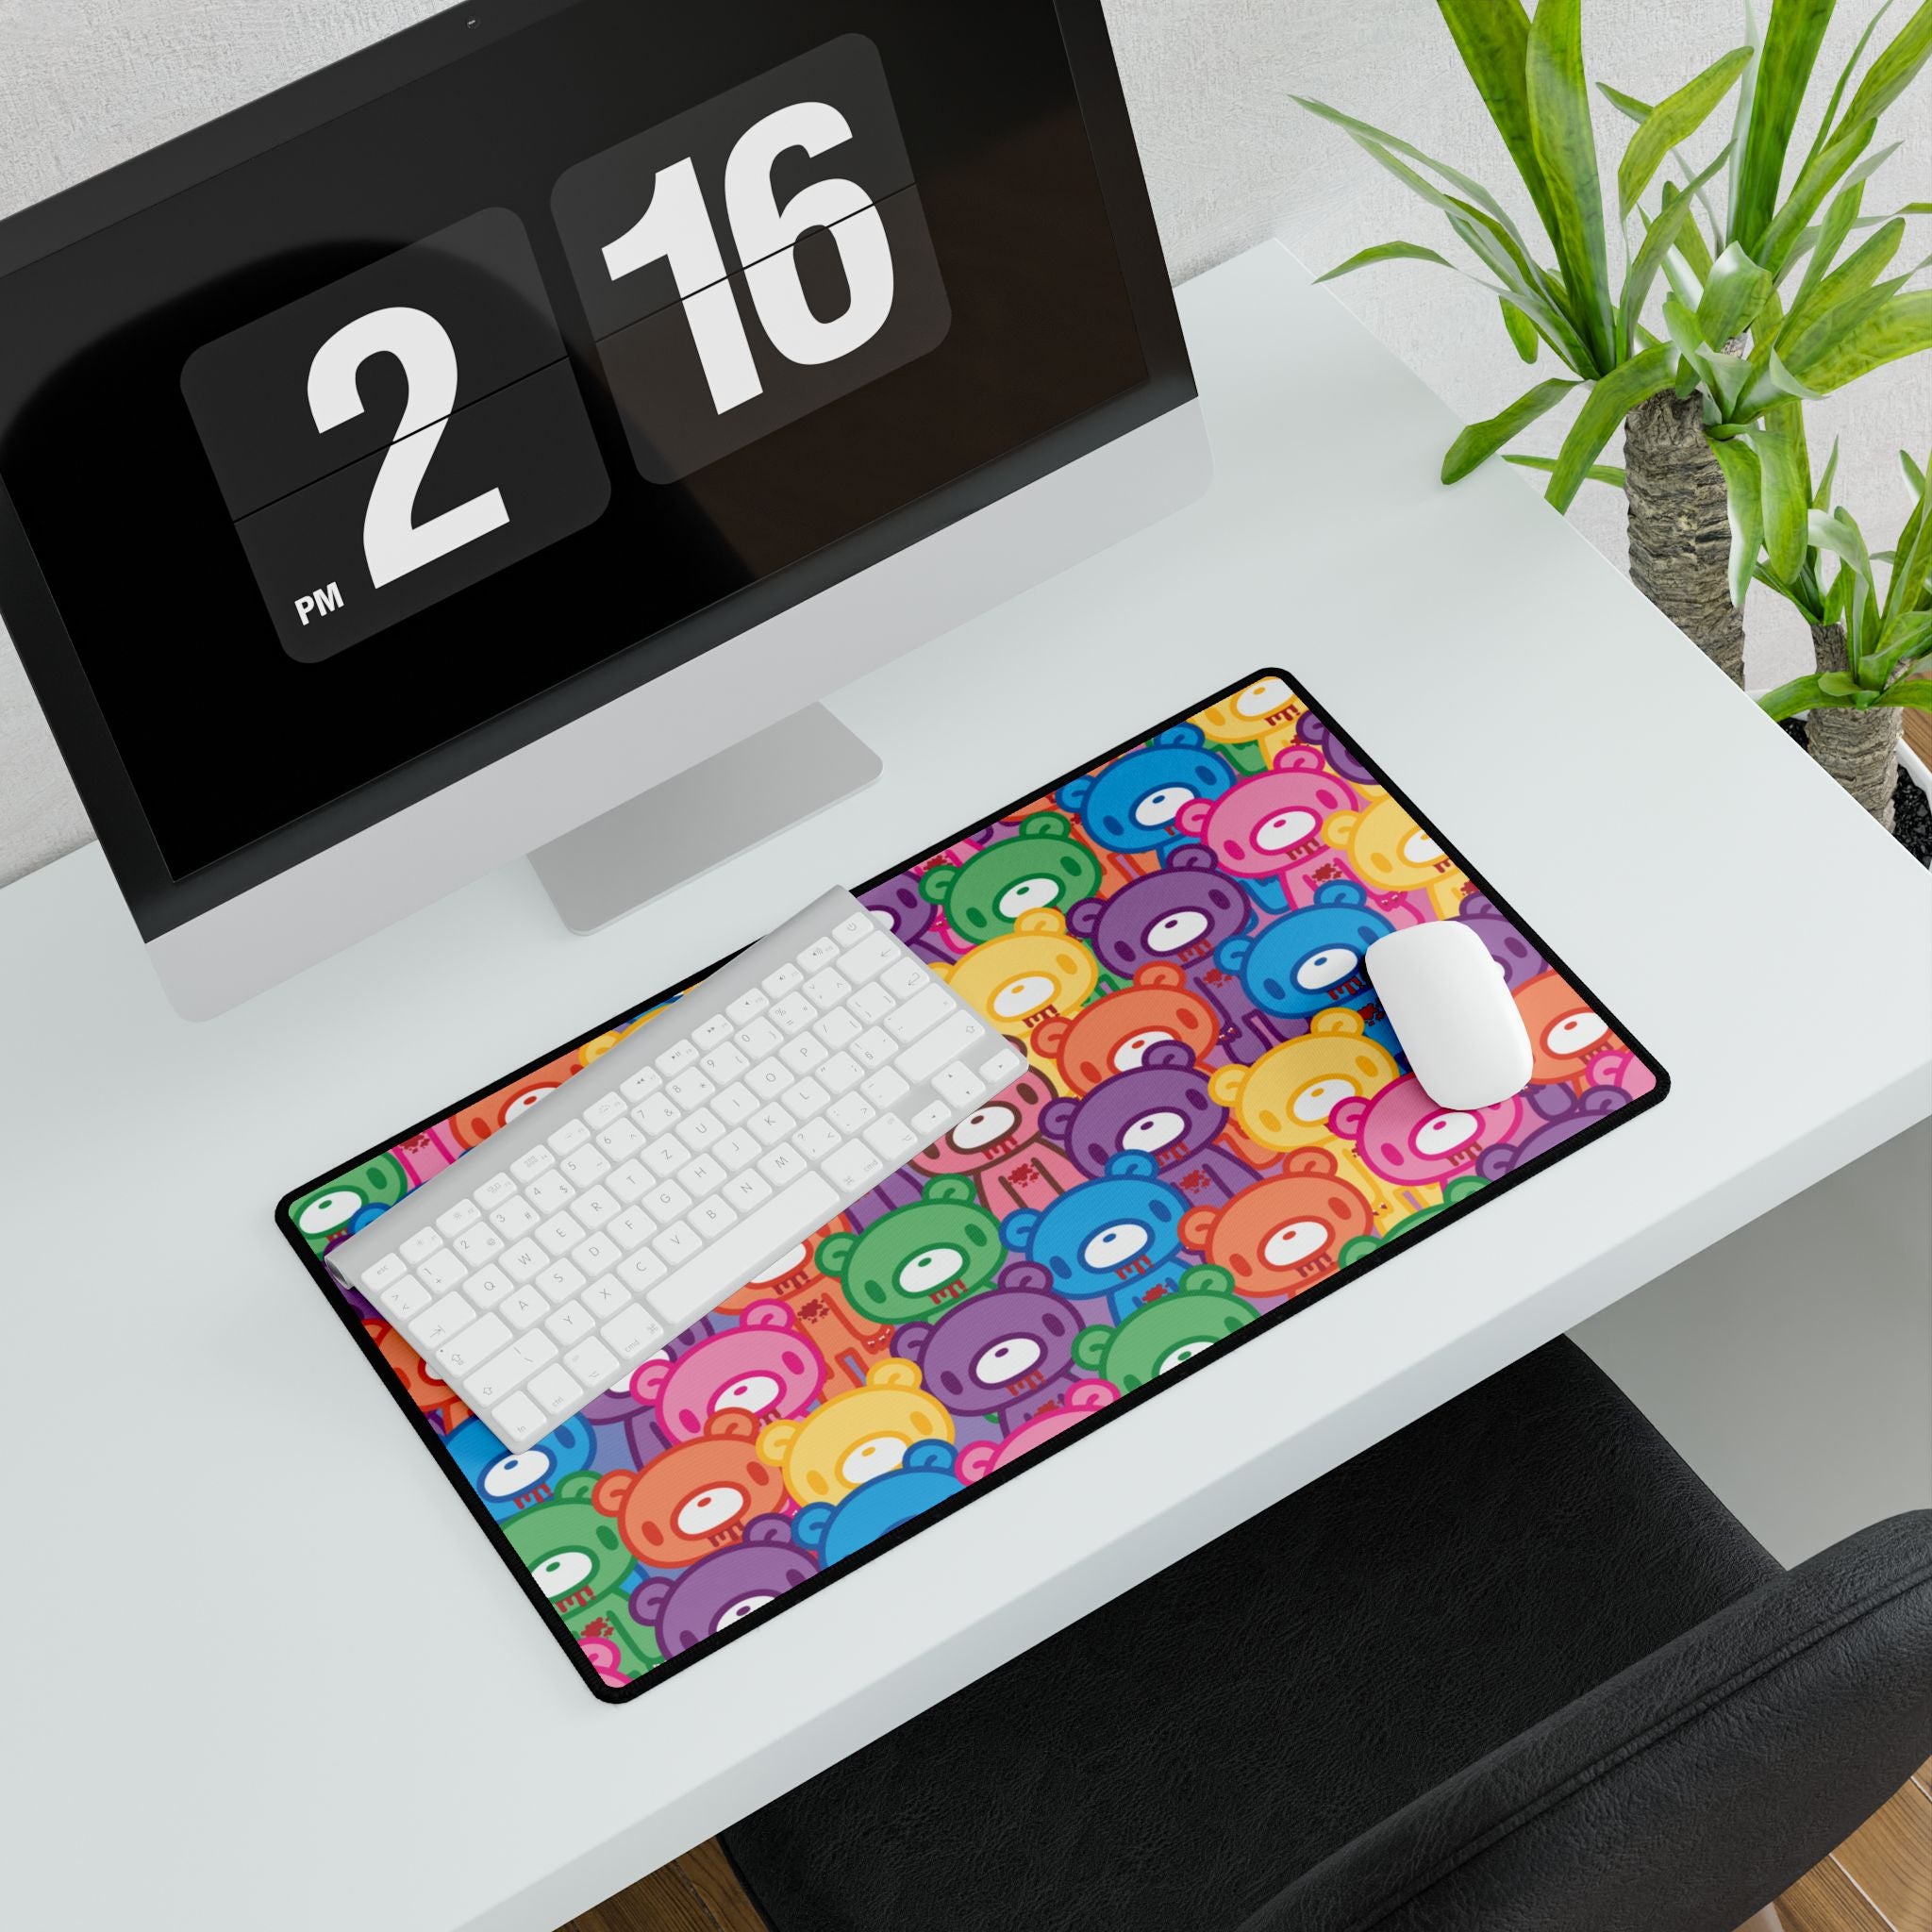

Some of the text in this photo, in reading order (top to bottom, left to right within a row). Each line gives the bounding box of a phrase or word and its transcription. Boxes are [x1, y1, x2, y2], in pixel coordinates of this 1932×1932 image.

[308, 102, 893, 590] 2 16
[294, 582, 343, 625] PM
[460, 1240, 470, 1250] 2
[496, 1214, 506, 1223] 3
[533, 1187, 541, 1195] 4
[567, 1161, 576, 1171] 5
[604, 1136, 611, 1144] 6
[637, 1109, 645, 1119] 7
[672, 1085, 681, 1093] 8
[707, 1059, 715, 1068] 9
[484, 1281, 495, 1291] Q
[518, 1252, 531, 1265] W
[556, 1228, 566, 1238] E
[591, 1202, 603, 1212] R
[625, 1175, 636, 1185] T
[661, 1149, 673, 1160] Z
[695, 1123, 708, 1134] U
[799, 1047, 808, 1058] P
[519, 1300, 529, 1310] A
[553, 1274, 563, 1283] S
[588, 1246, 600, 1257] D
[625, 1220, 633, 1230] F
[659, 1193, 671, 1204] G
[693, 1167, 707, 1178] H
[732, 1141, 740, 1152] J
[764, 1116, 775, 1126] K
[562, 1315, 573, 1324] Y
[599, 1288, 612, 1299] X
[636, 1261, 647, 1272] C
[671, 1235, 680, 1244] V
[706, 1209, 717, 1220] B
[741, 1182, 753, 1193] N
[774, 1156, 789, 1169] M
